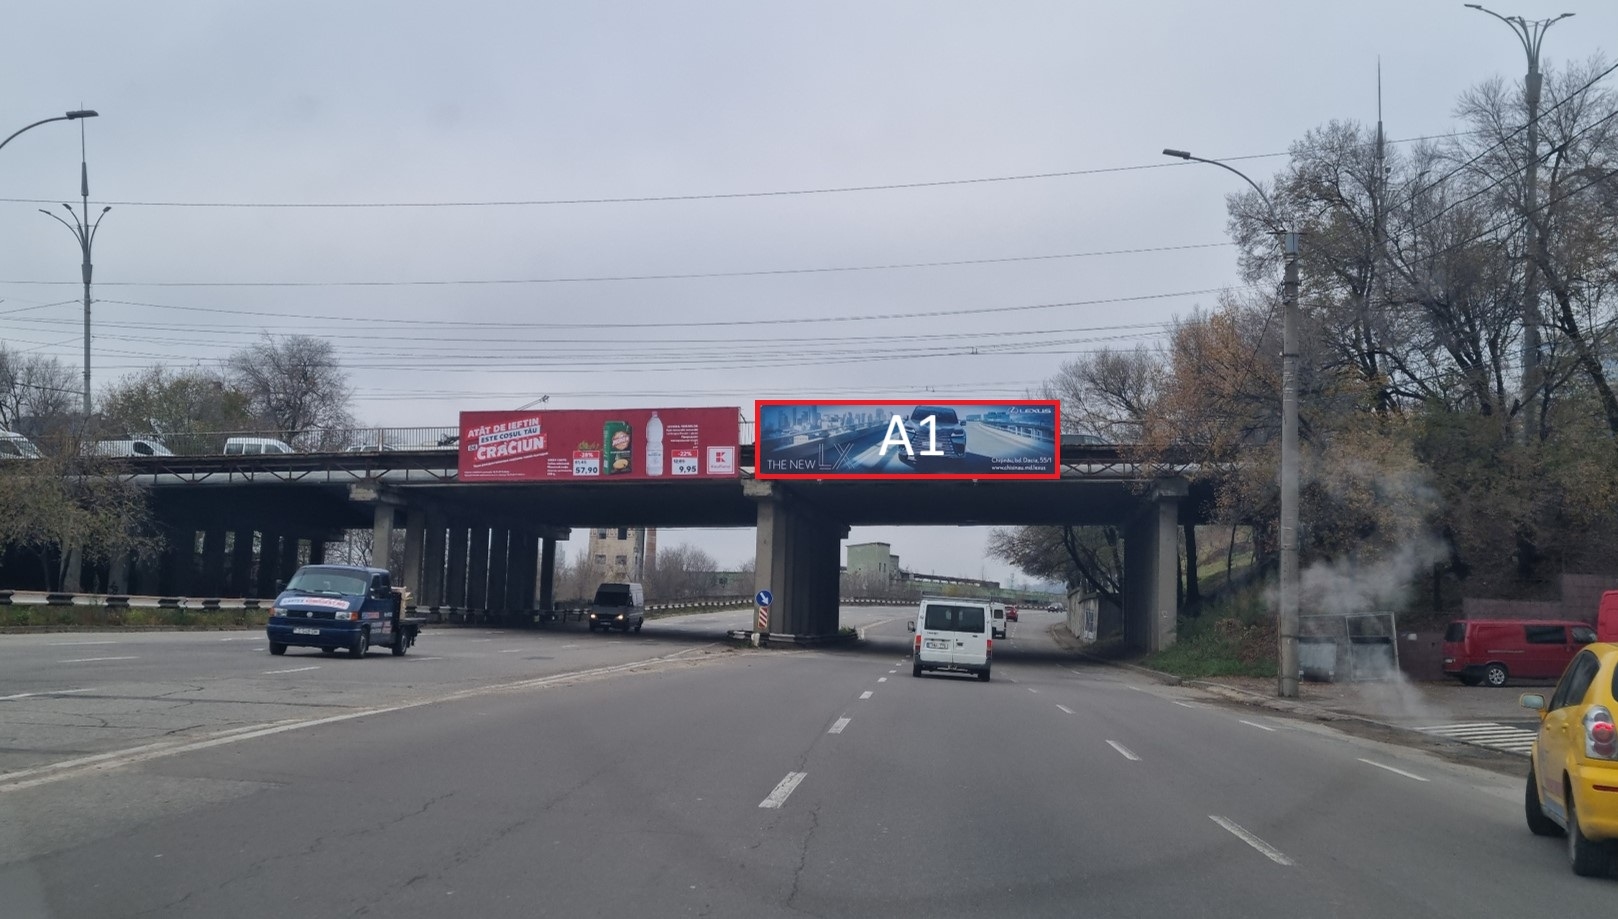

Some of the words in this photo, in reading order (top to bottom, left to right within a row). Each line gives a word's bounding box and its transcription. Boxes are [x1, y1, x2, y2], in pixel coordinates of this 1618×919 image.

[493, 423, 506, 433] DE
[508, 417, 539, 430] IEFTIN
[481, 435, 498, 443] ESTE
[767, 460, 787, 470] THE
[790, 460, 816, 470] NEW
[818, 443, 854, 471] LX
[575, 466, 598, 474] 57,90
[679, 465, 697, 473] 9,95
